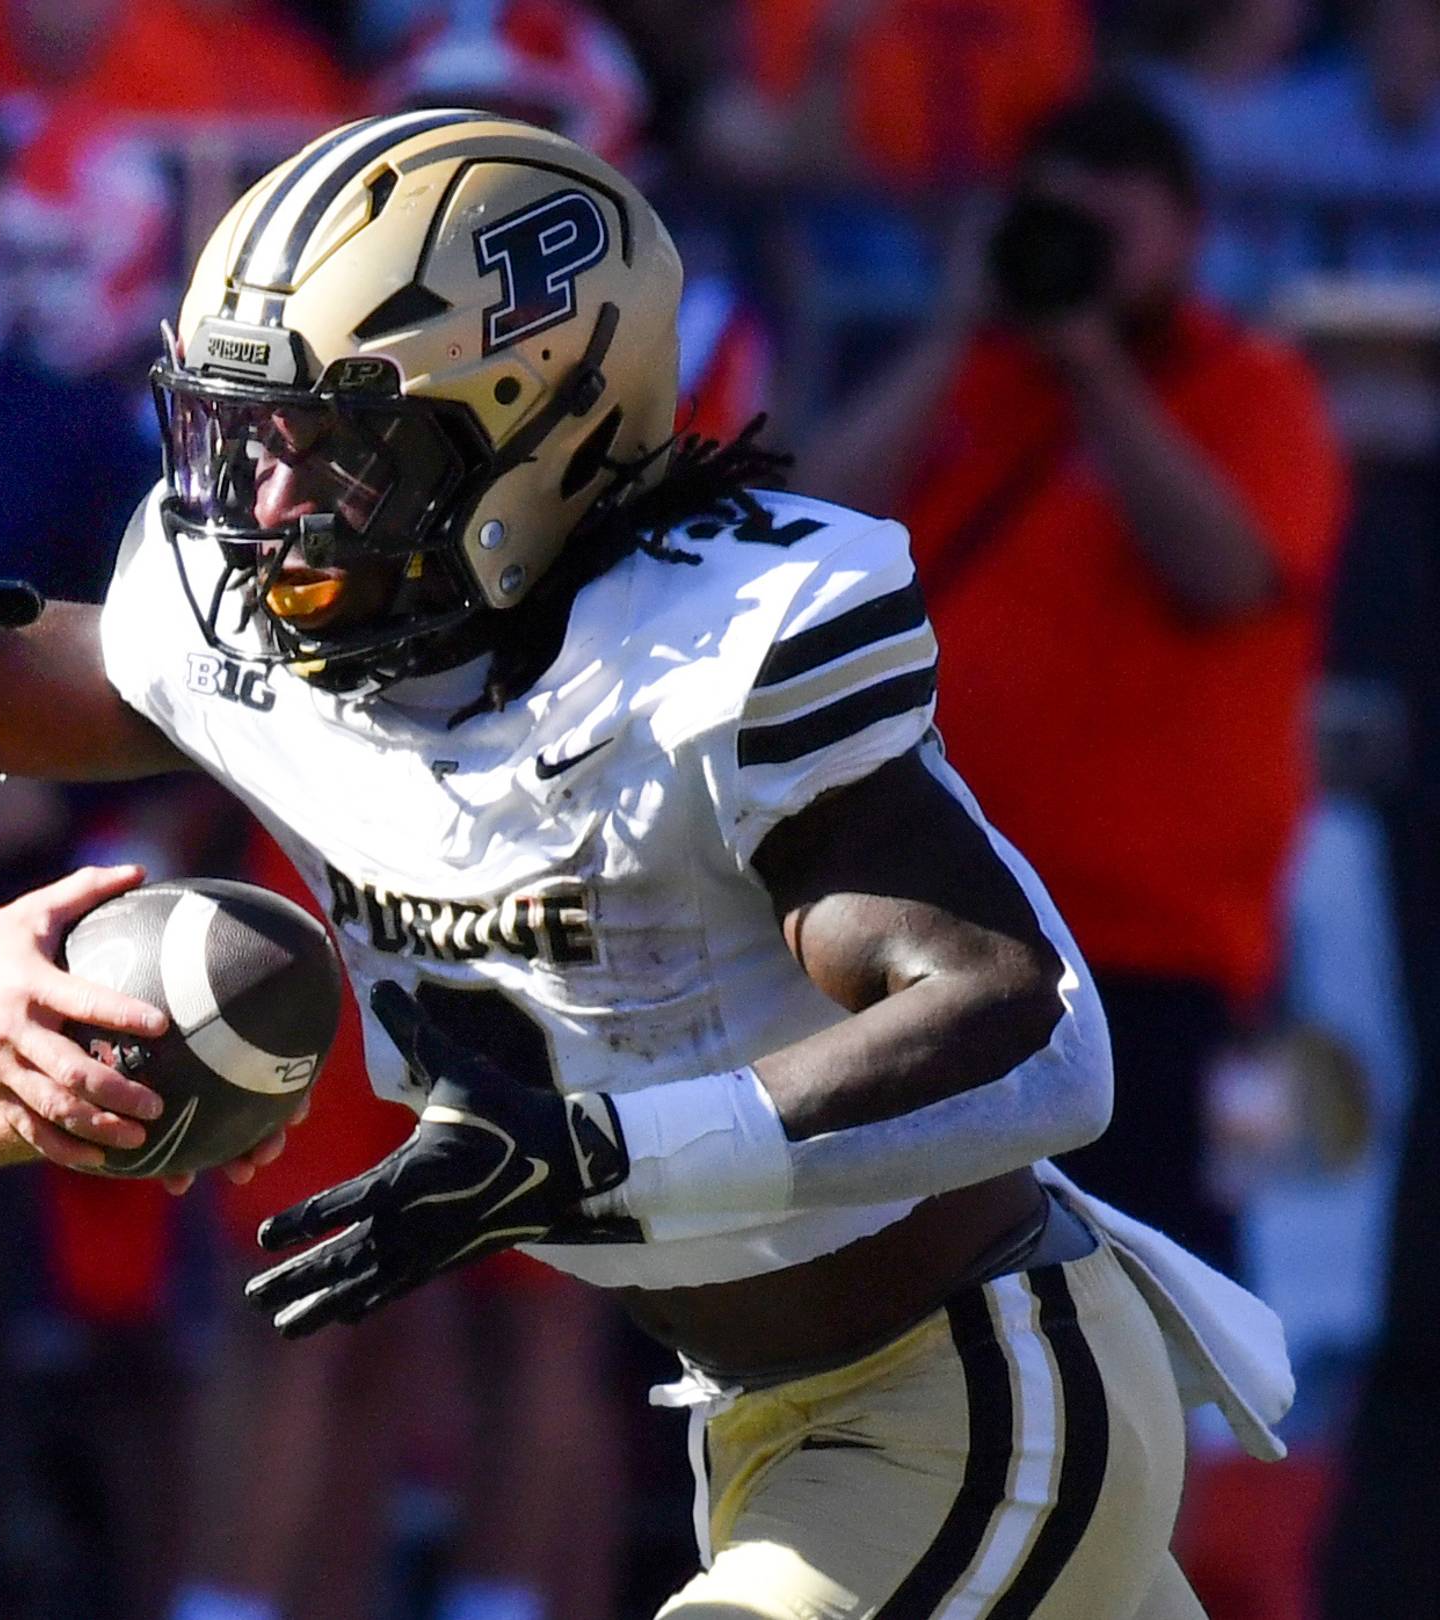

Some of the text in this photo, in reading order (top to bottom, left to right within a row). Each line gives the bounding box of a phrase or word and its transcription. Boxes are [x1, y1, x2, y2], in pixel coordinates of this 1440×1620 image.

[473, 189, 610, 357] P
[338, 361, 383, 387] P
[324, 863, 602, 969] PURDUE
